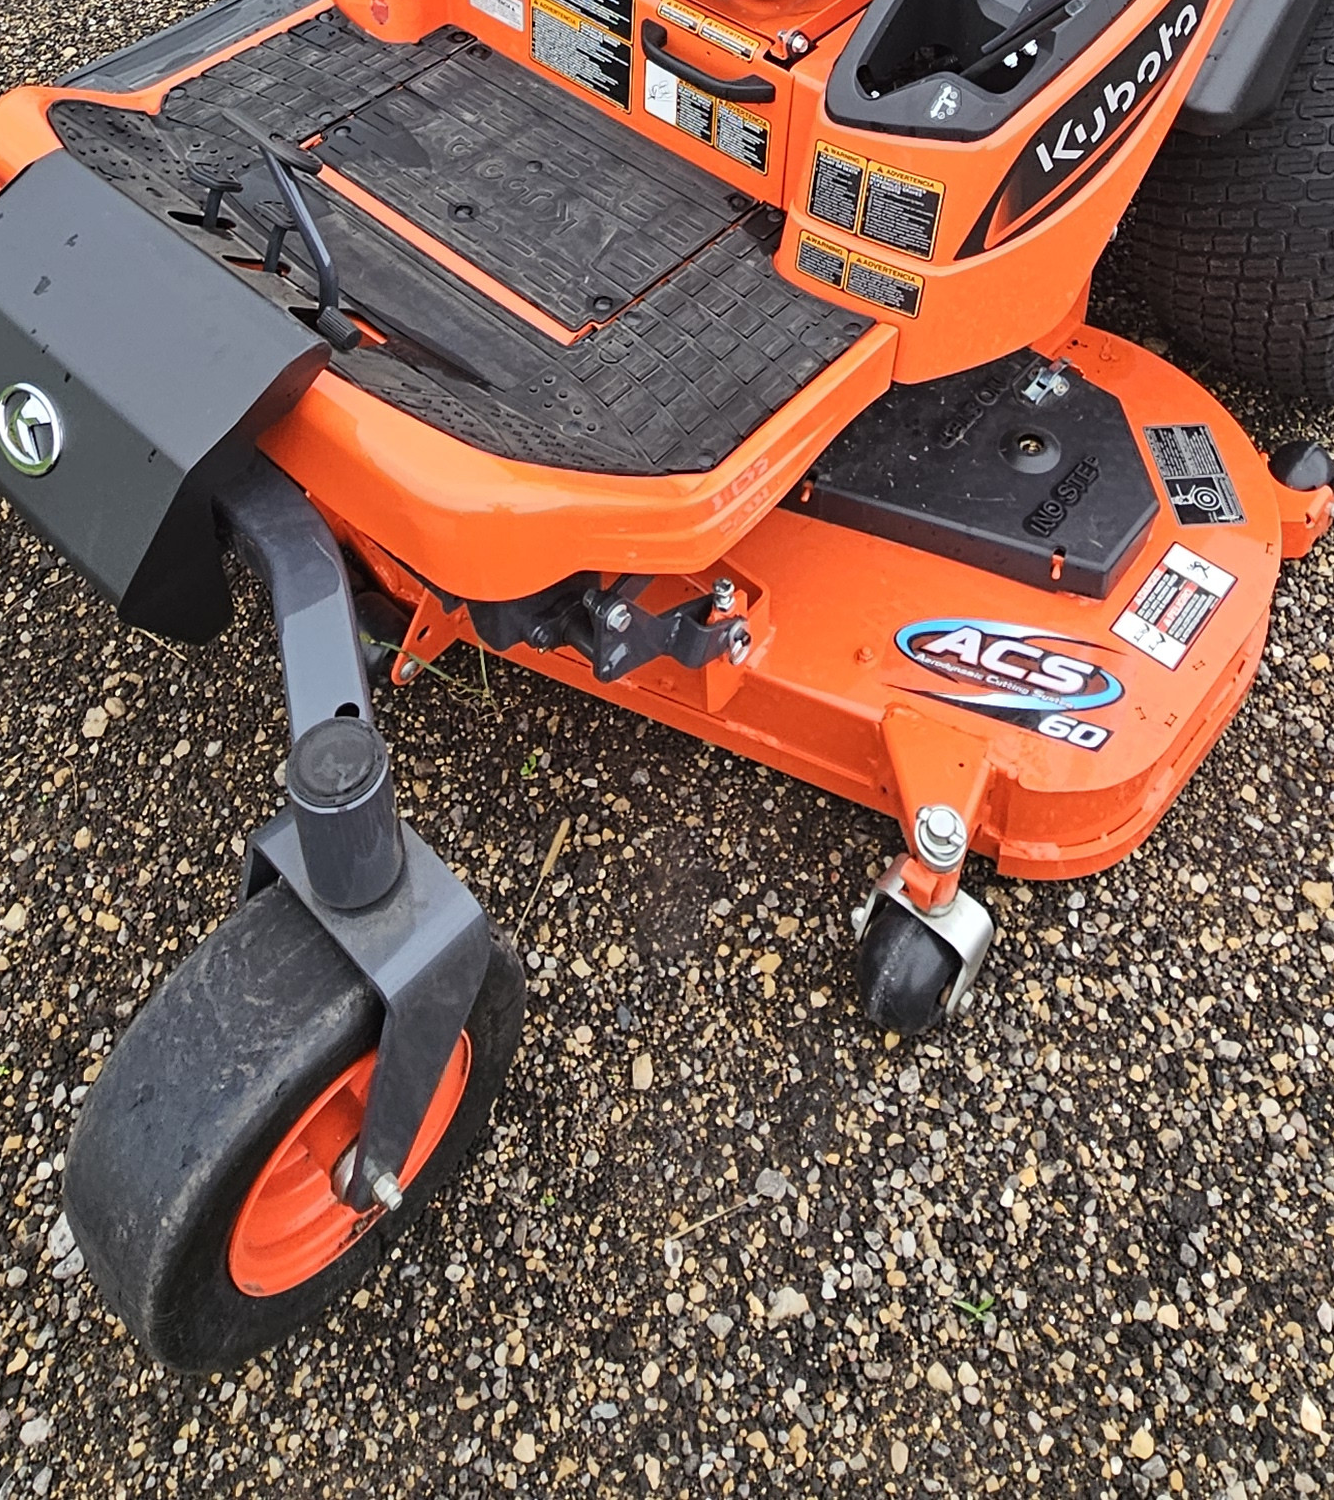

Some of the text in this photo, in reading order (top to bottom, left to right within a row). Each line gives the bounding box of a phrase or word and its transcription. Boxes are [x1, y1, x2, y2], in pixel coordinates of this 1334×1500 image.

[1035, 3, 1198, 172] Kubota
[831, 148, 860, 165] WARNING
[886, 169, 935, 189] ADVERTENCIA
[811, 237, 842, 256] WARNING
[863, 259, 916, 283] ADVERTENCIA
[1030, 454, 1101, 535] NO STEP
[921, 625, 1095, 695] ACS
[914, 652, 1075, 710] Aerodynamic Cutting System
[1038, 714, 1108, 748] 60
